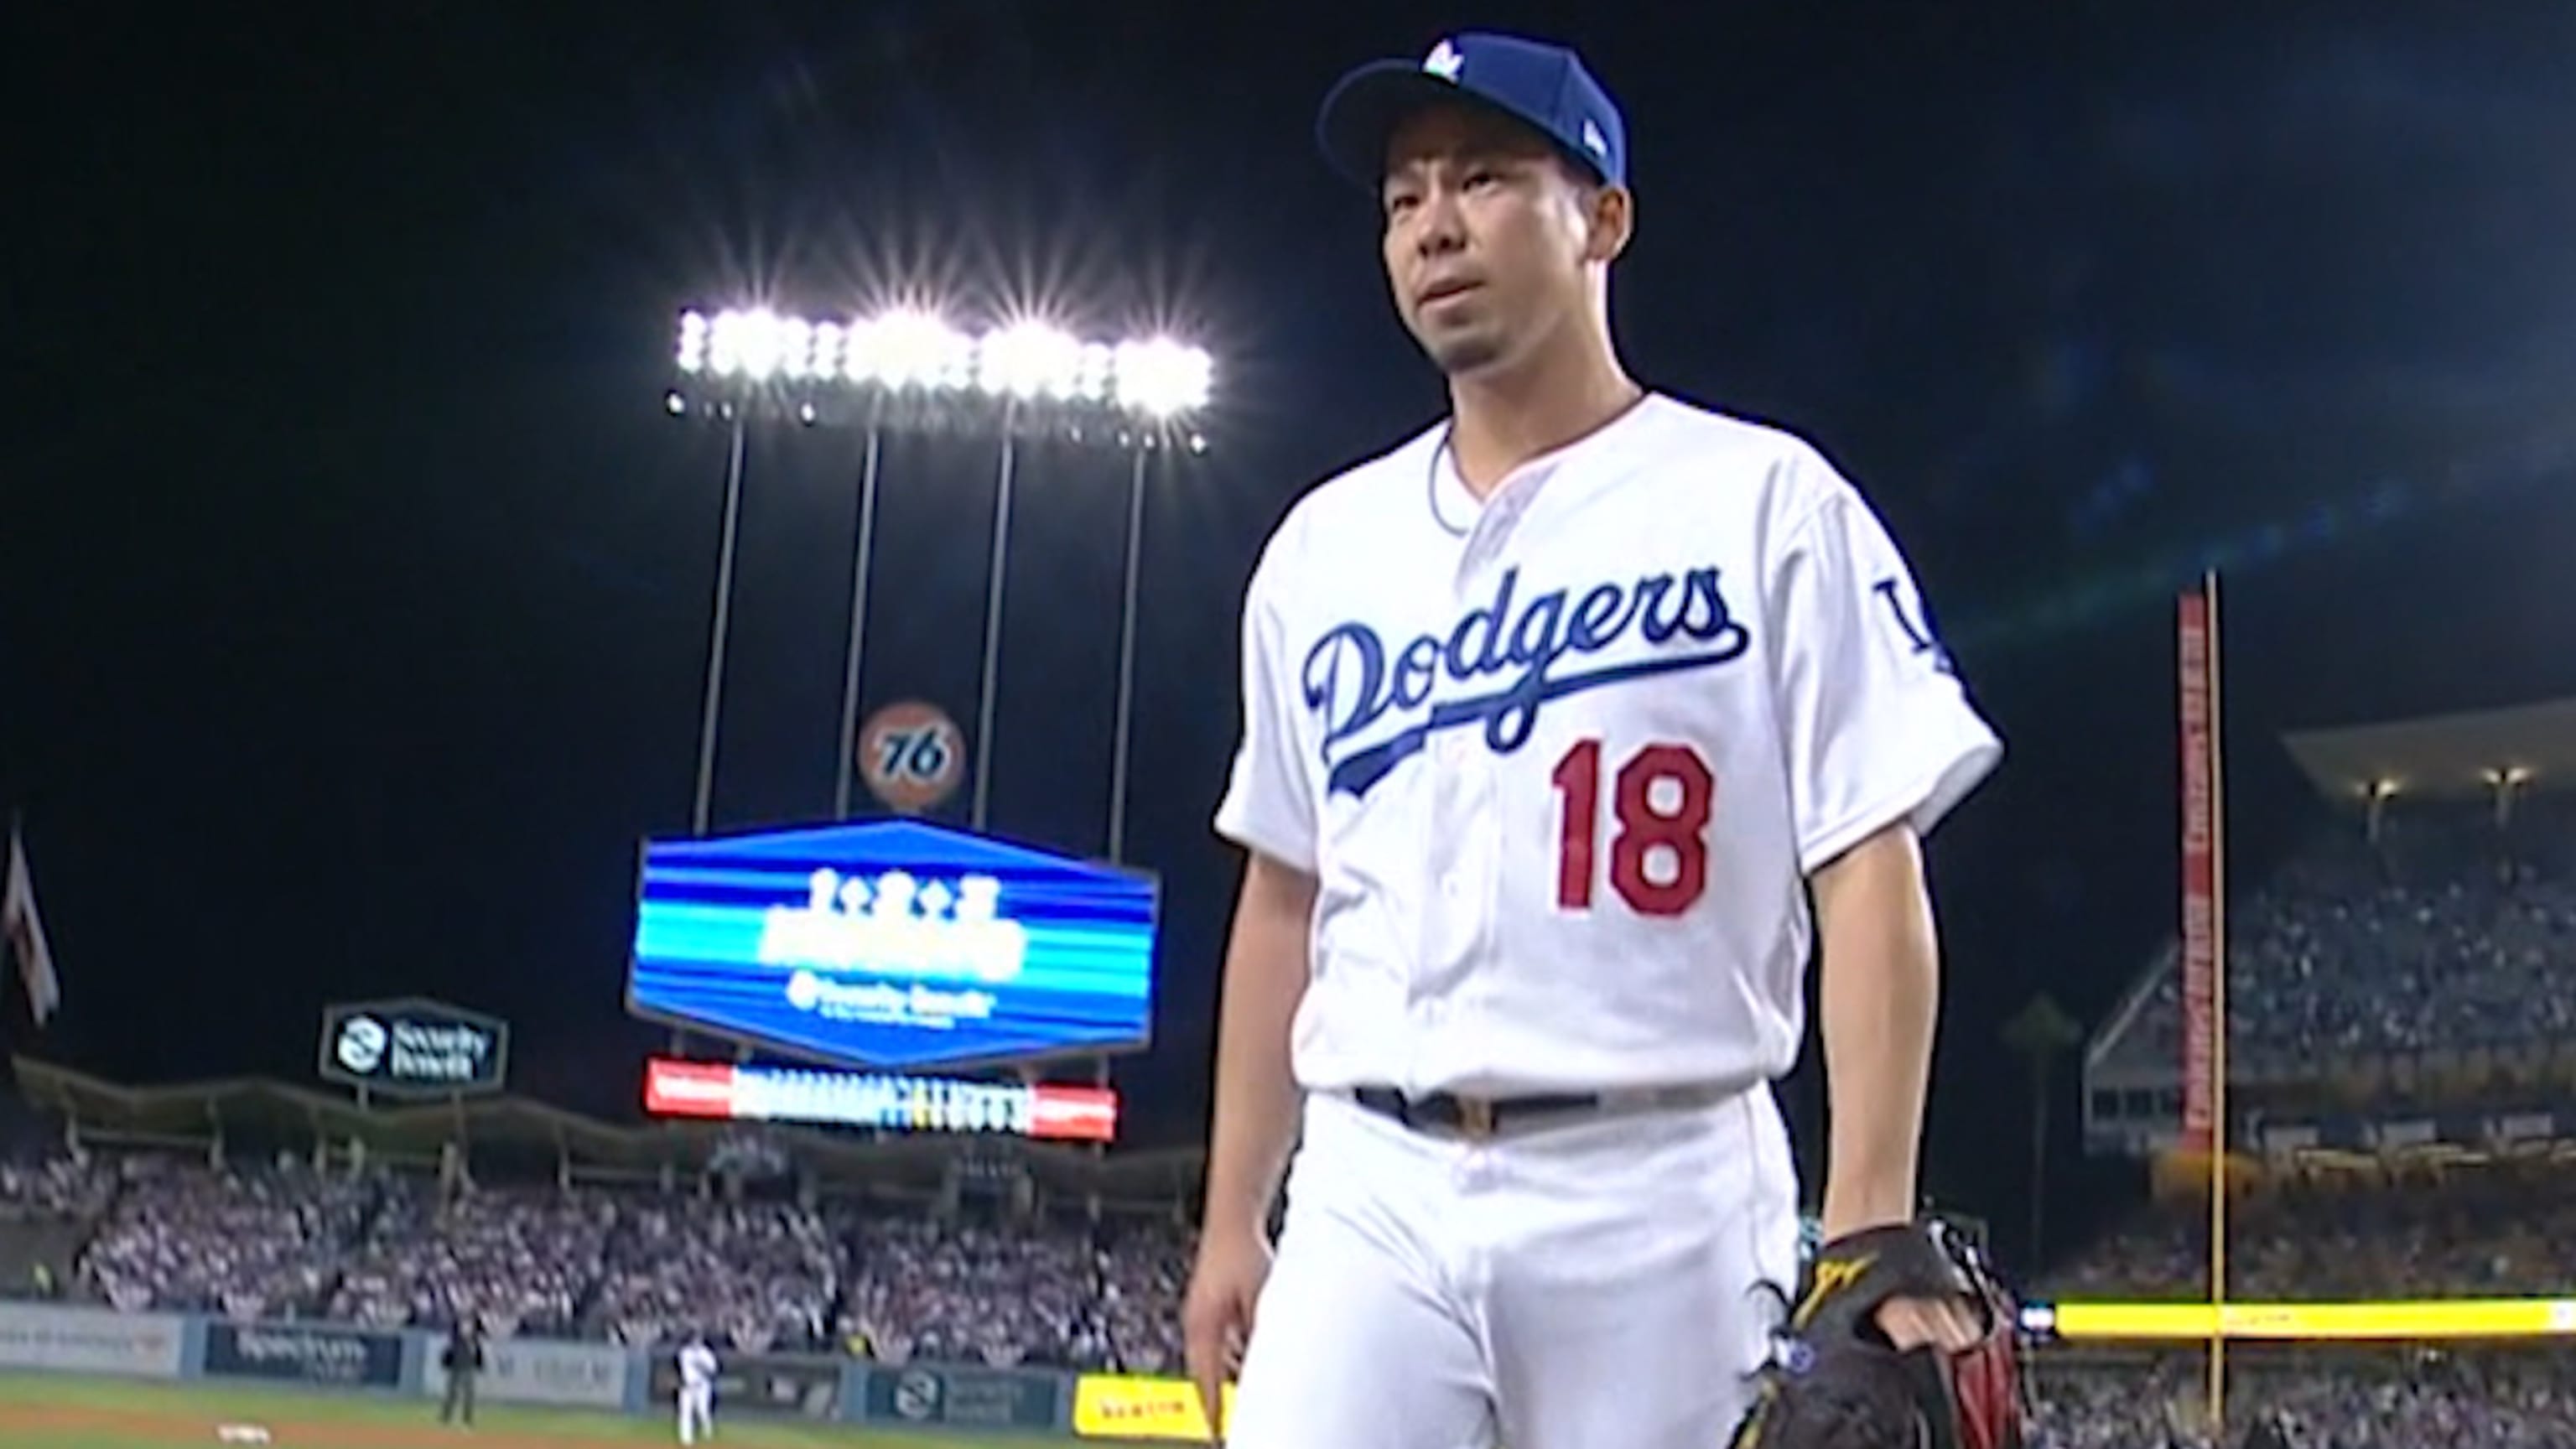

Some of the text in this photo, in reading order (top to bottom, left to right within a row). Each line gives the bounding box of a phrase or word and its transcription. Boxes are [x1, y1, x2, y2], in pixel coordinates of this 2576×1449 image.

[879, 724, 947, 780] 76
[1303, 564, 1749, 766] Dodgers
[1552, 739, 1715, 917] 18
